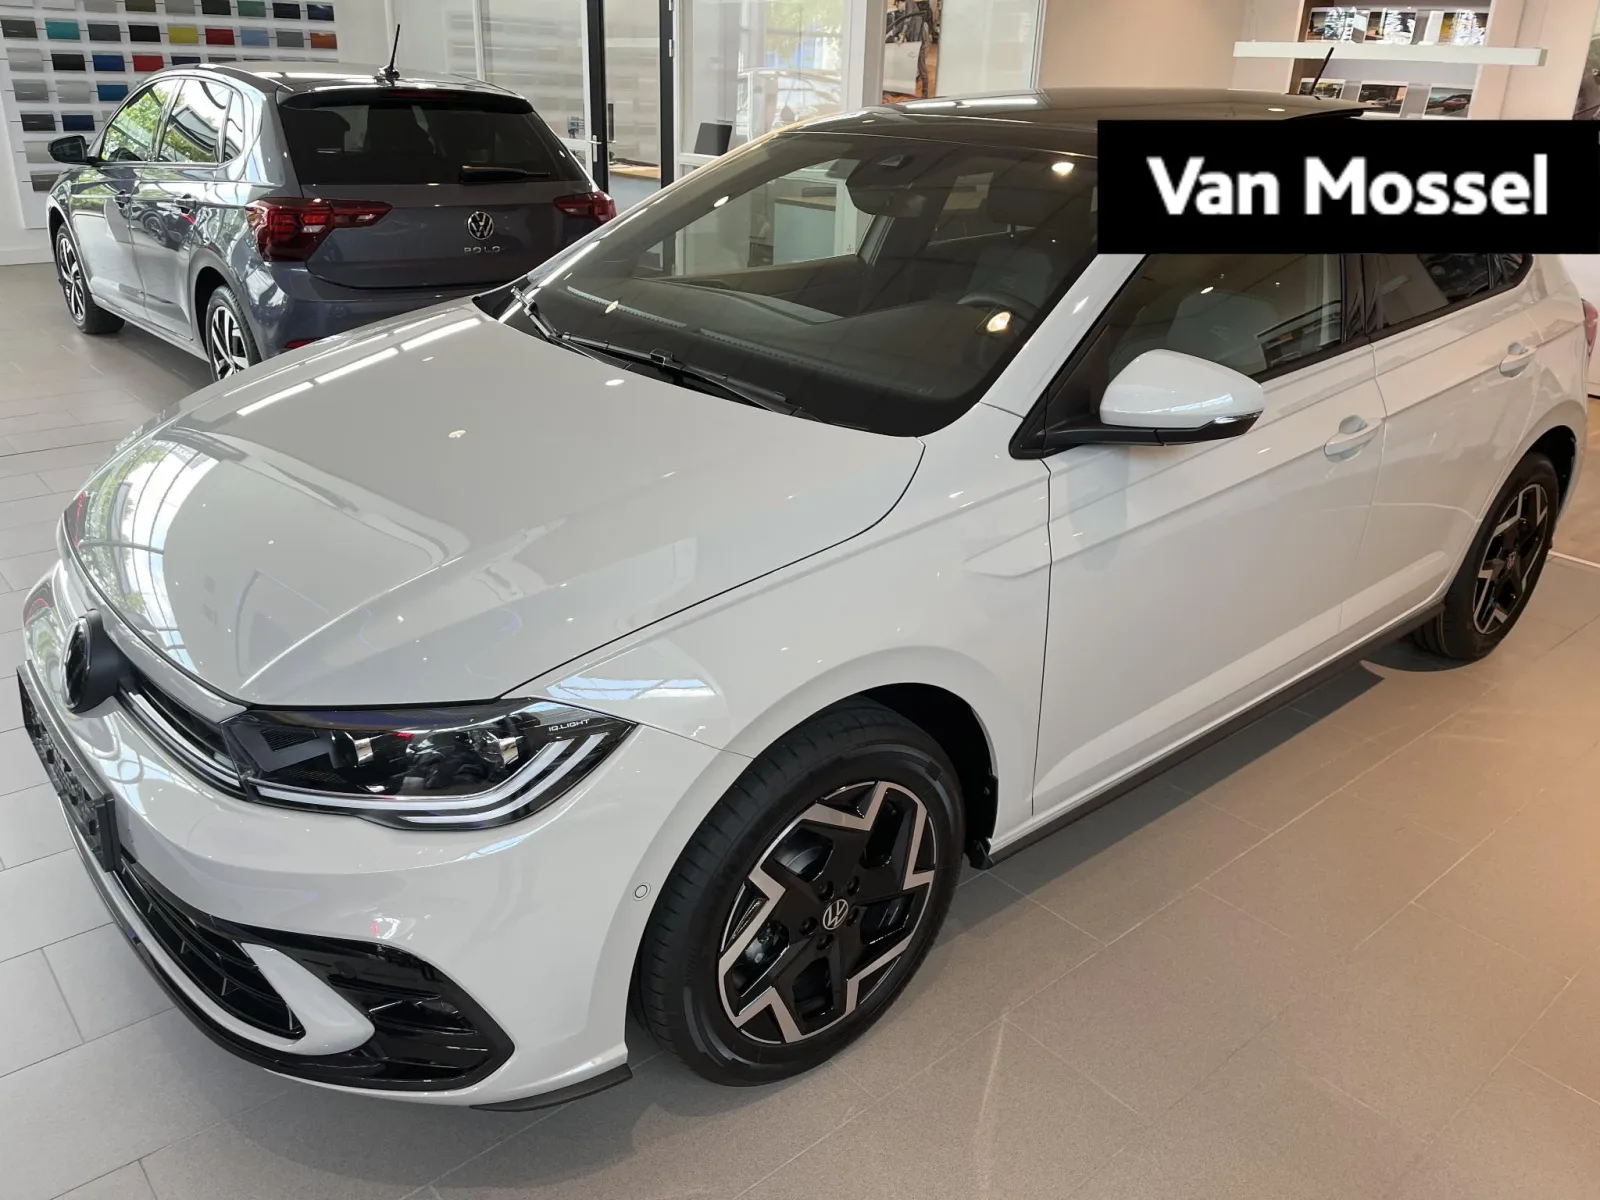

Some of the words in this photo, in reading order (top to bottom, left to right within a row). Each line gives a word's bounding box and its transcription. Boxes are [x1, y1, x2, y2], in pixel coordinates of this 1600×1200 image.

[463, 245, 501, 254] POLO
[548, 718, 590, 732] IQ.LIGHT
[822, 898, 849, 930] VW
